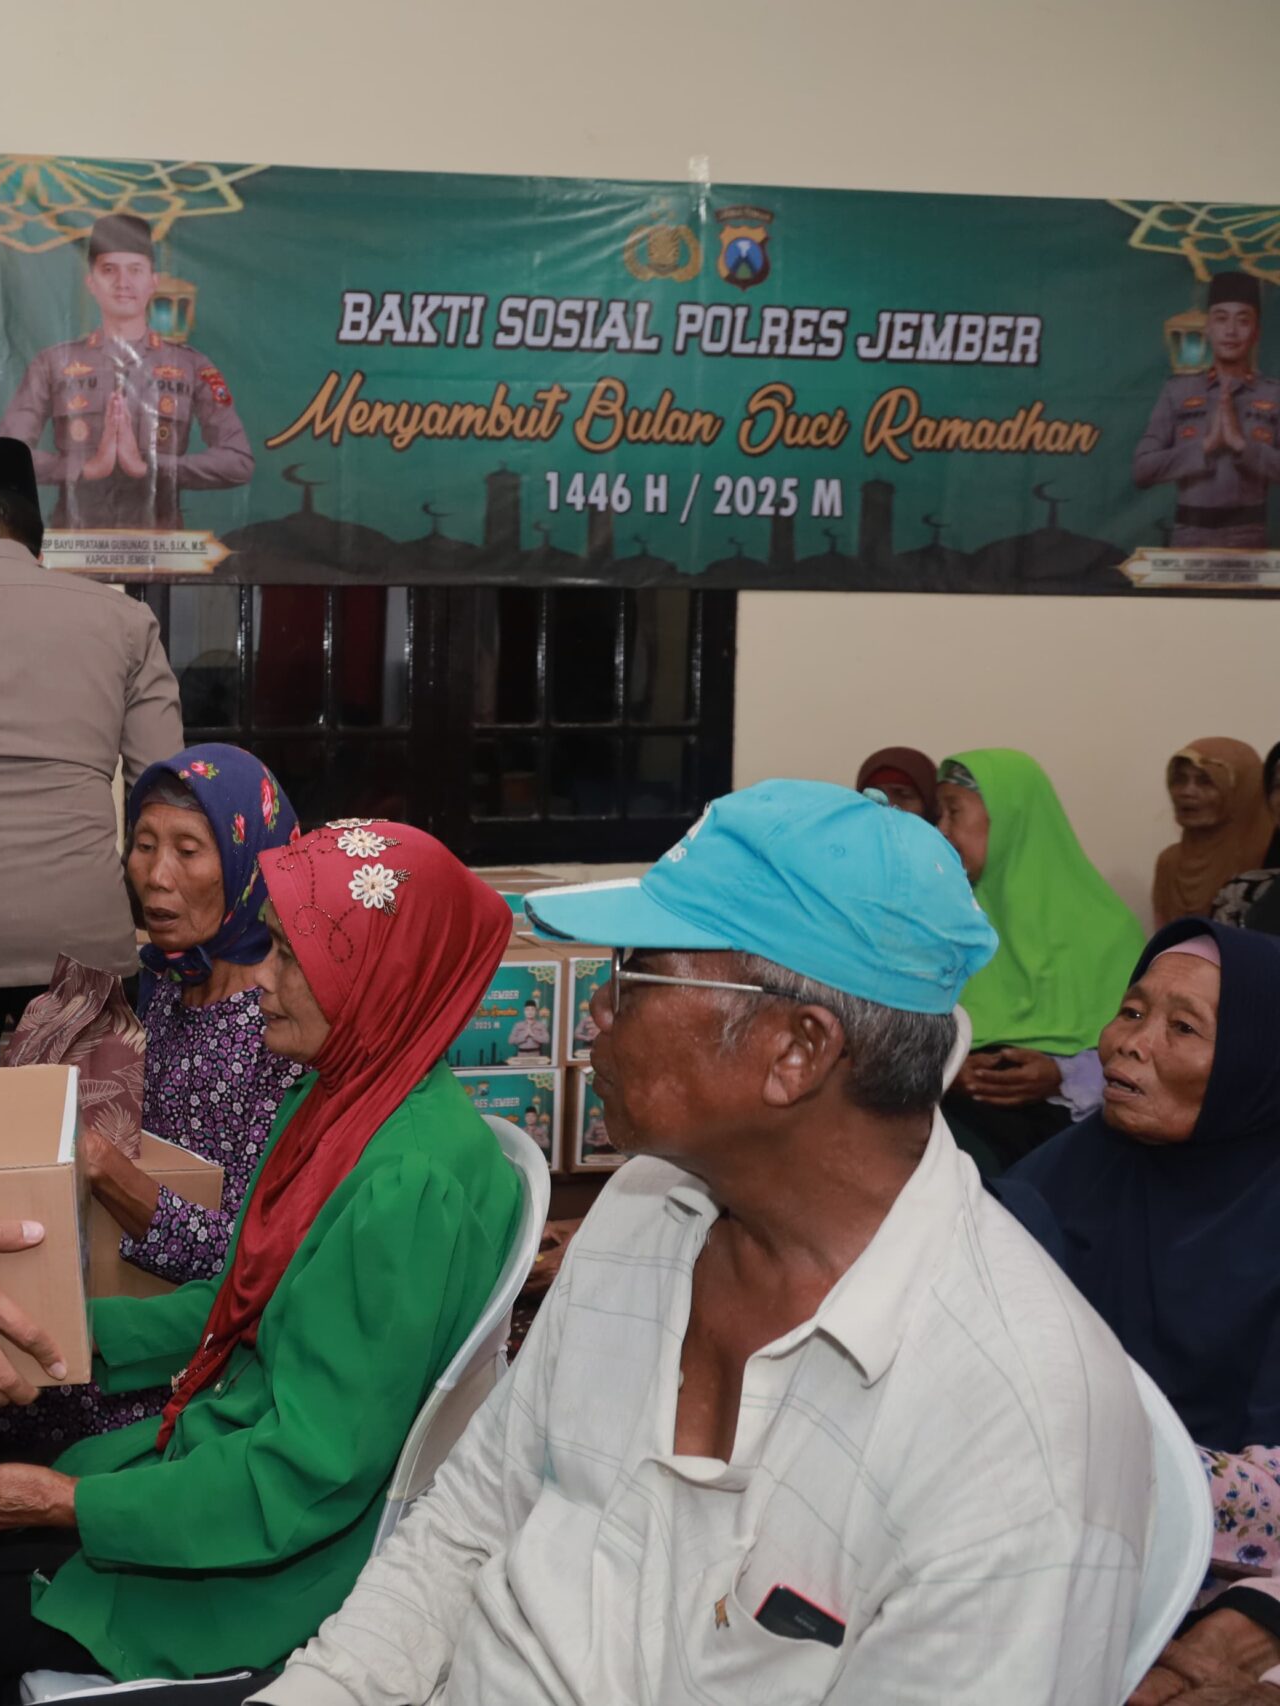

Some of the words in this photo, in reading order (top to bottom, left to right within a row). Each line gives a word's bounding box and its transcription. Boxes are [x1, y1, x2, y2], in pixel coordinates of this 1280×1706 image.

[337, 291, 486, 347] BAKTI
[494, 296, 662, 352] SOSIAL
[674, 303, 848, 361] POLRES
[856, 310, 1042, 366] JEMBER
[264, 370, 570, 451] Menyambut
[574, 376, 723, 454] Bulan
[737, 380, 851, 456] Suci
[860, 386, 1099, 462] Ramadhan
[545, 471, 632, 514] 1446
[644, 474, 668, 514] H
[679, 473, 701, 524] /
[713, 476, 799, 517] 2025
[811, 478, 844, 518] M
[86, 554, 124, 565] KAPOLRES
[127, 555, 156, 565] JEMBER
